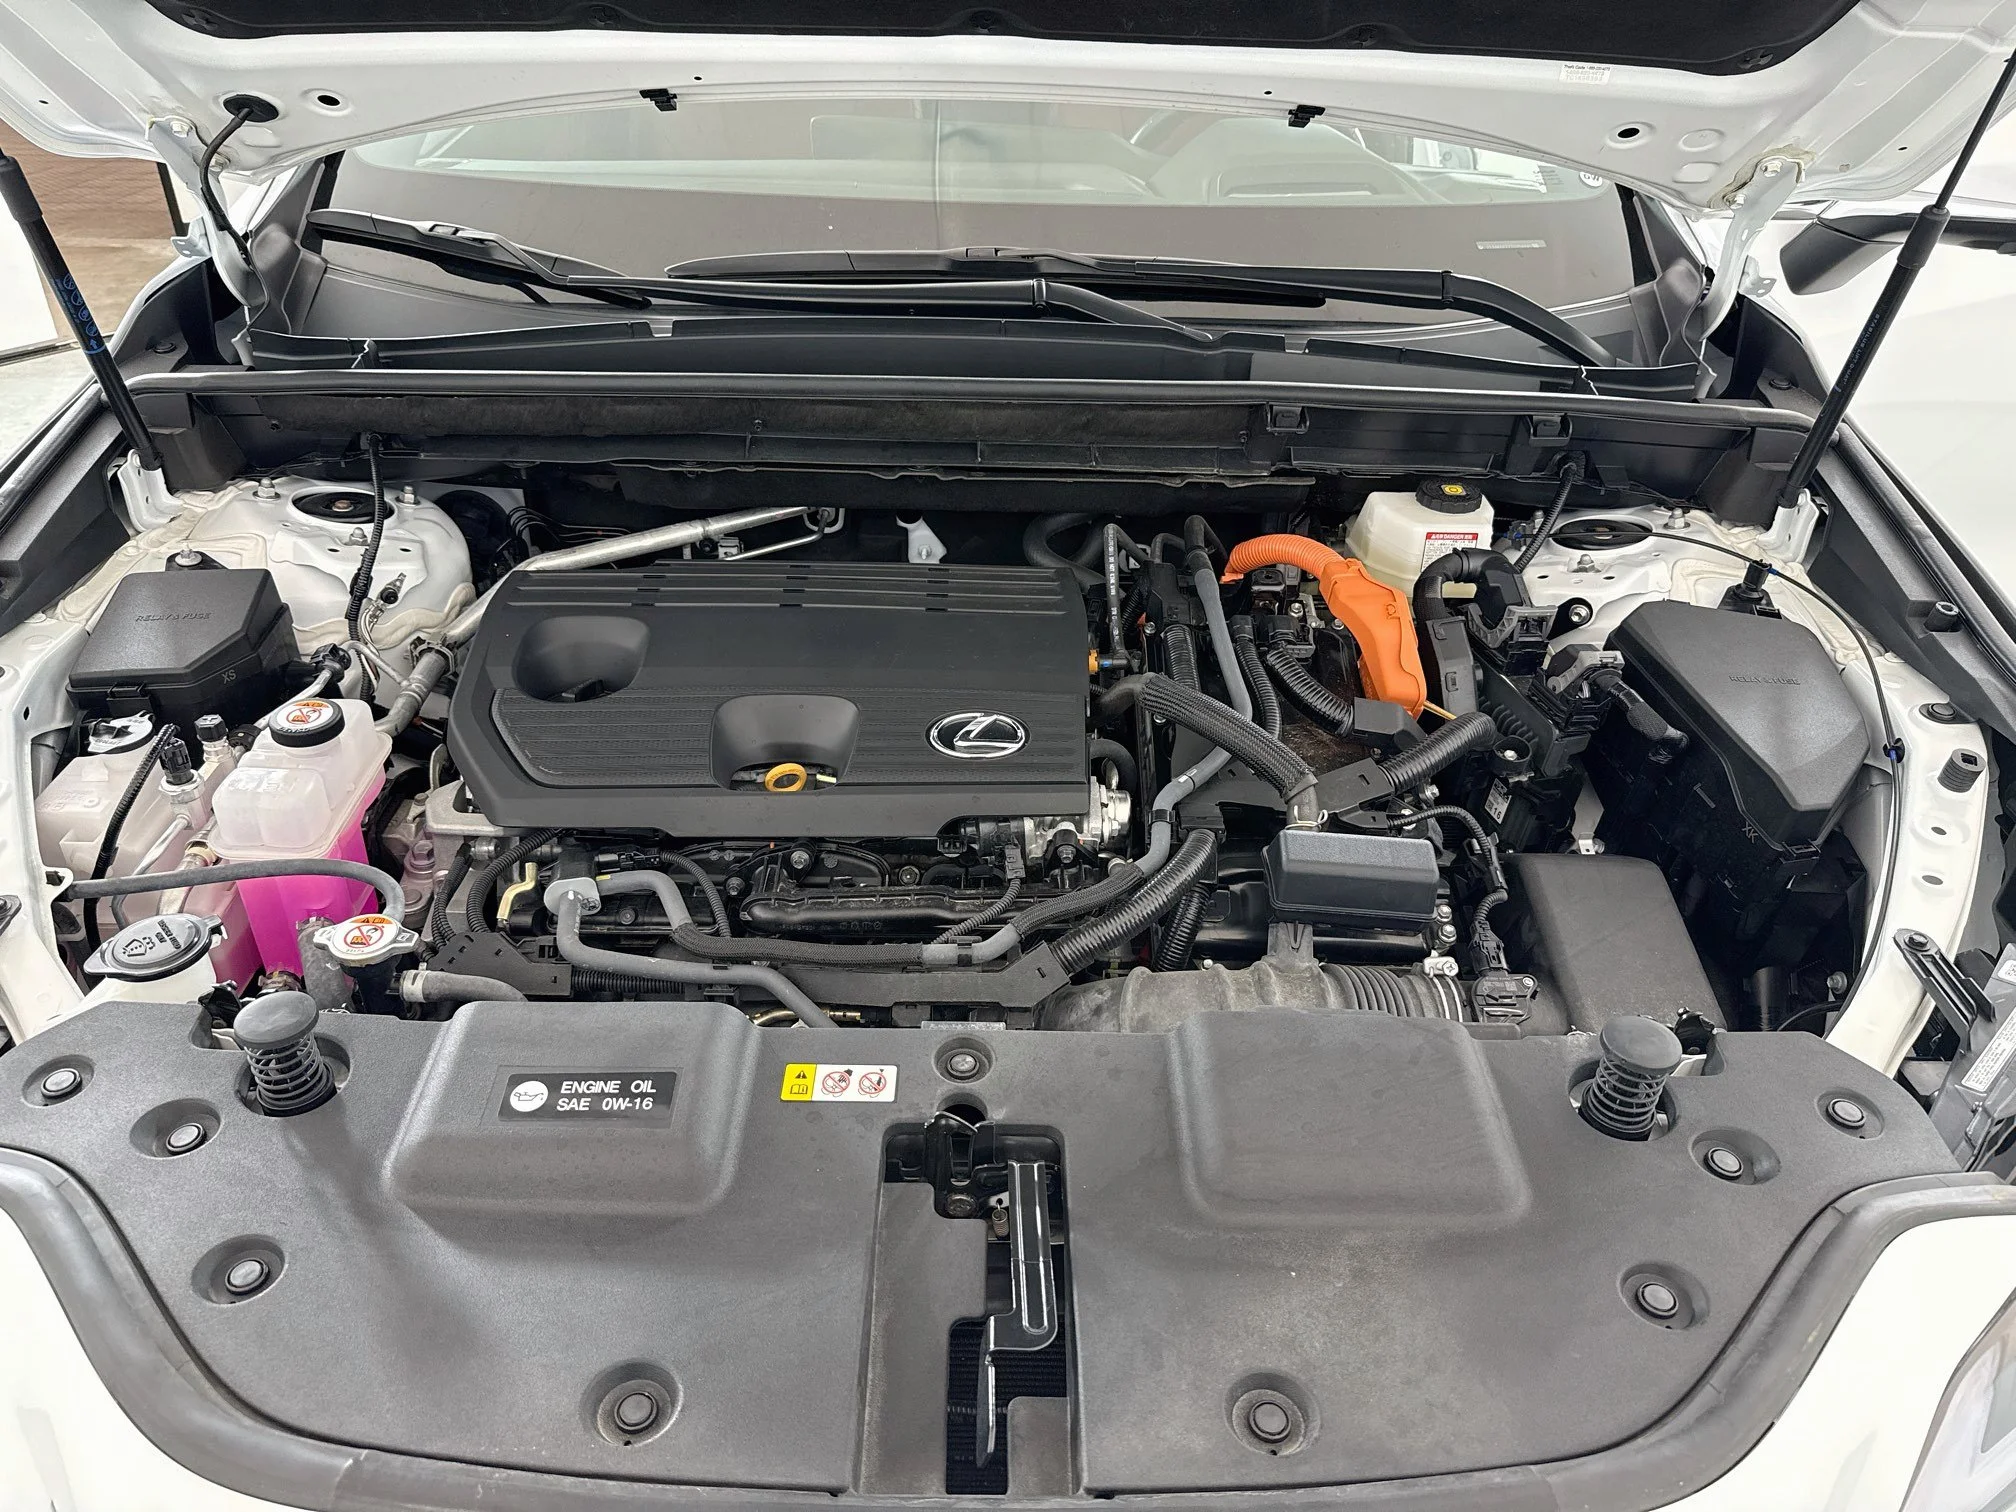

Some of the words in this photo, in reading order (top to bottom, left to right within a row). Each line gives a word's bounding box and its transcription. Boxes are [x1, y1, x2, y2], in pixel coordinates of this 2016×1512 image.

[135, 613, 172, 622] RELAY
[181, 612, 213, 621] FUSE
[221, 669, 237, 685] XS
[1728, 674, 1763, 683] RELAY
[1741, 821, 1759, 843] XK
[560, 1080, 622, 1094] ENGINE
[630, 1080, 657, 1093] OIL
[556, 1097, 591, 1111] SAE
[601, 1097, 654, 1111] 0W-16
